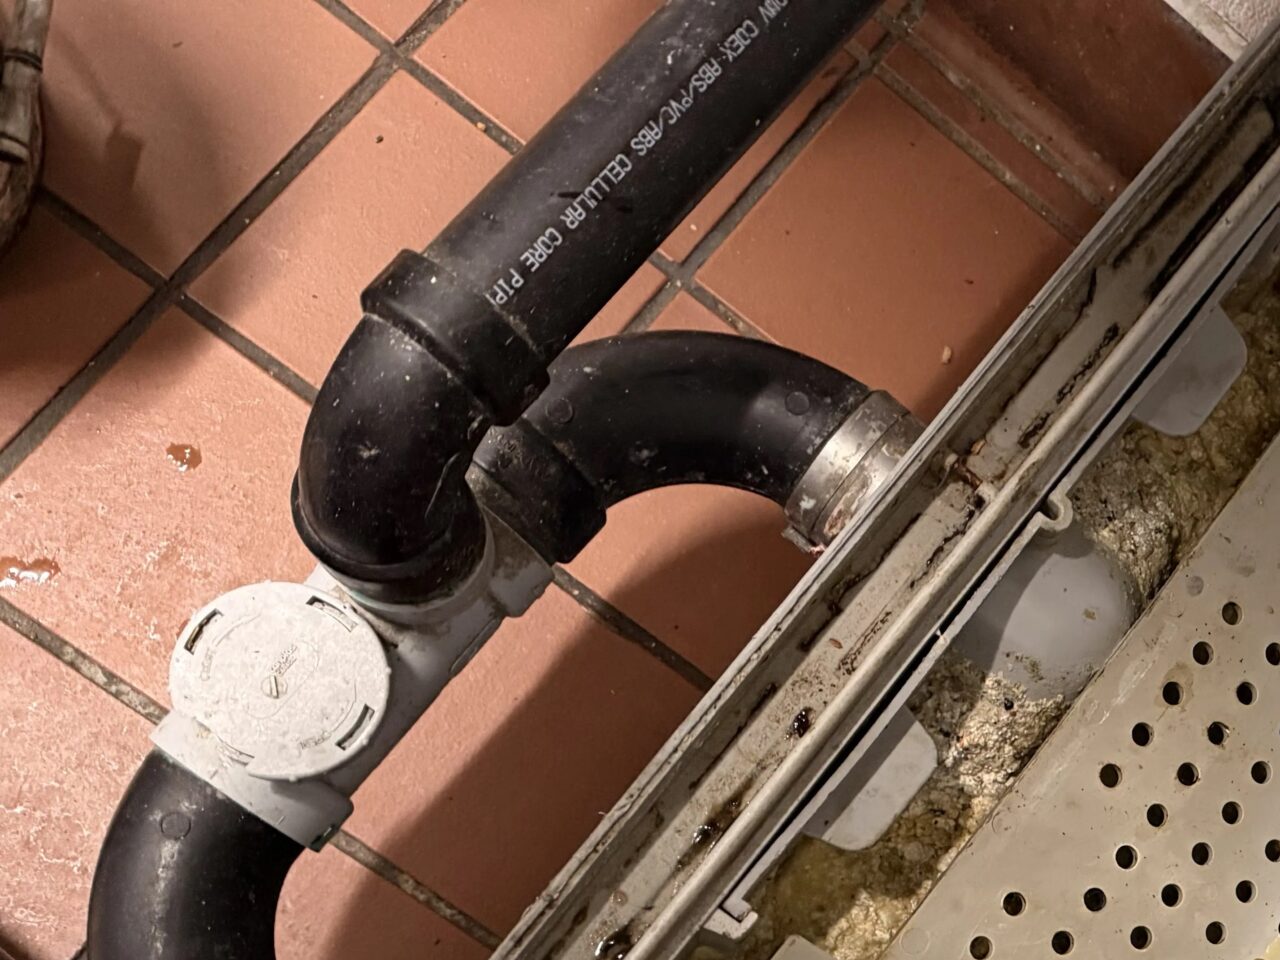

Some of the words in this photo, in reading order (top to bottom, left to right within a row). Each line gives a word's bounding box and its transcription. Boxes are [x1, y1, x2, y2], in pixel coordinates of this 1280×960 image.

[719, 19, 759, 62] COEX
[630, 57, 722, 156] ABS/PVC/ABS
[560, 153, 633, 229] CELLULAR
[519, 227, 563, 272] CORE
